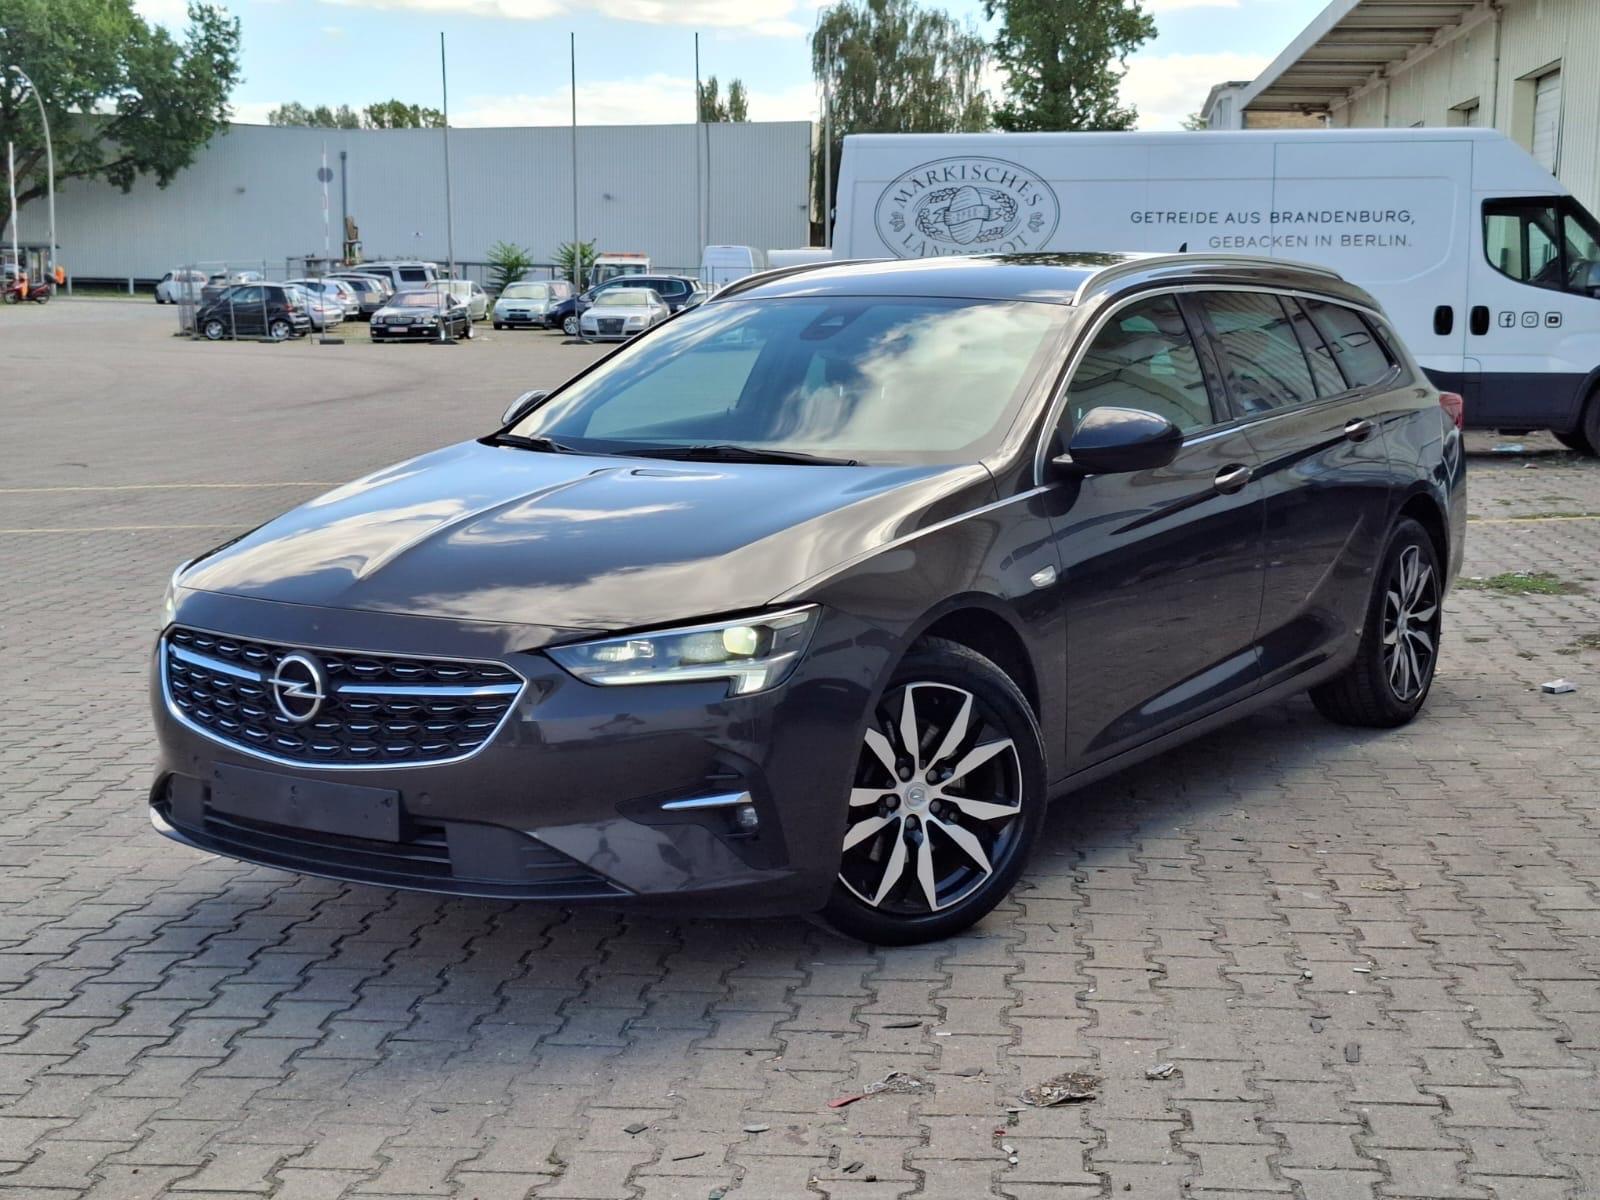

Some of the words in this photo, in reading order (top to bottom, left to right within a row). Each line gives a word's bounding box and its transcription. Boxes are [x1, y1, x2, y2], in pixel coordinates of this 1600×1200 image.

[894, 165, 1043, 209] MÄRKISCHES
[1130, 211, 1219, 224] GETREIDE
[1224, 211, 1261, 224] AUS
[1269, 210, 1415, 225] BRANDENBURG,
[1208, 235, 1308, 248] GEBACKEN
[1315, 234, 1332, 248] IN
[1340, 234, 1412, 247] BERLIN.
